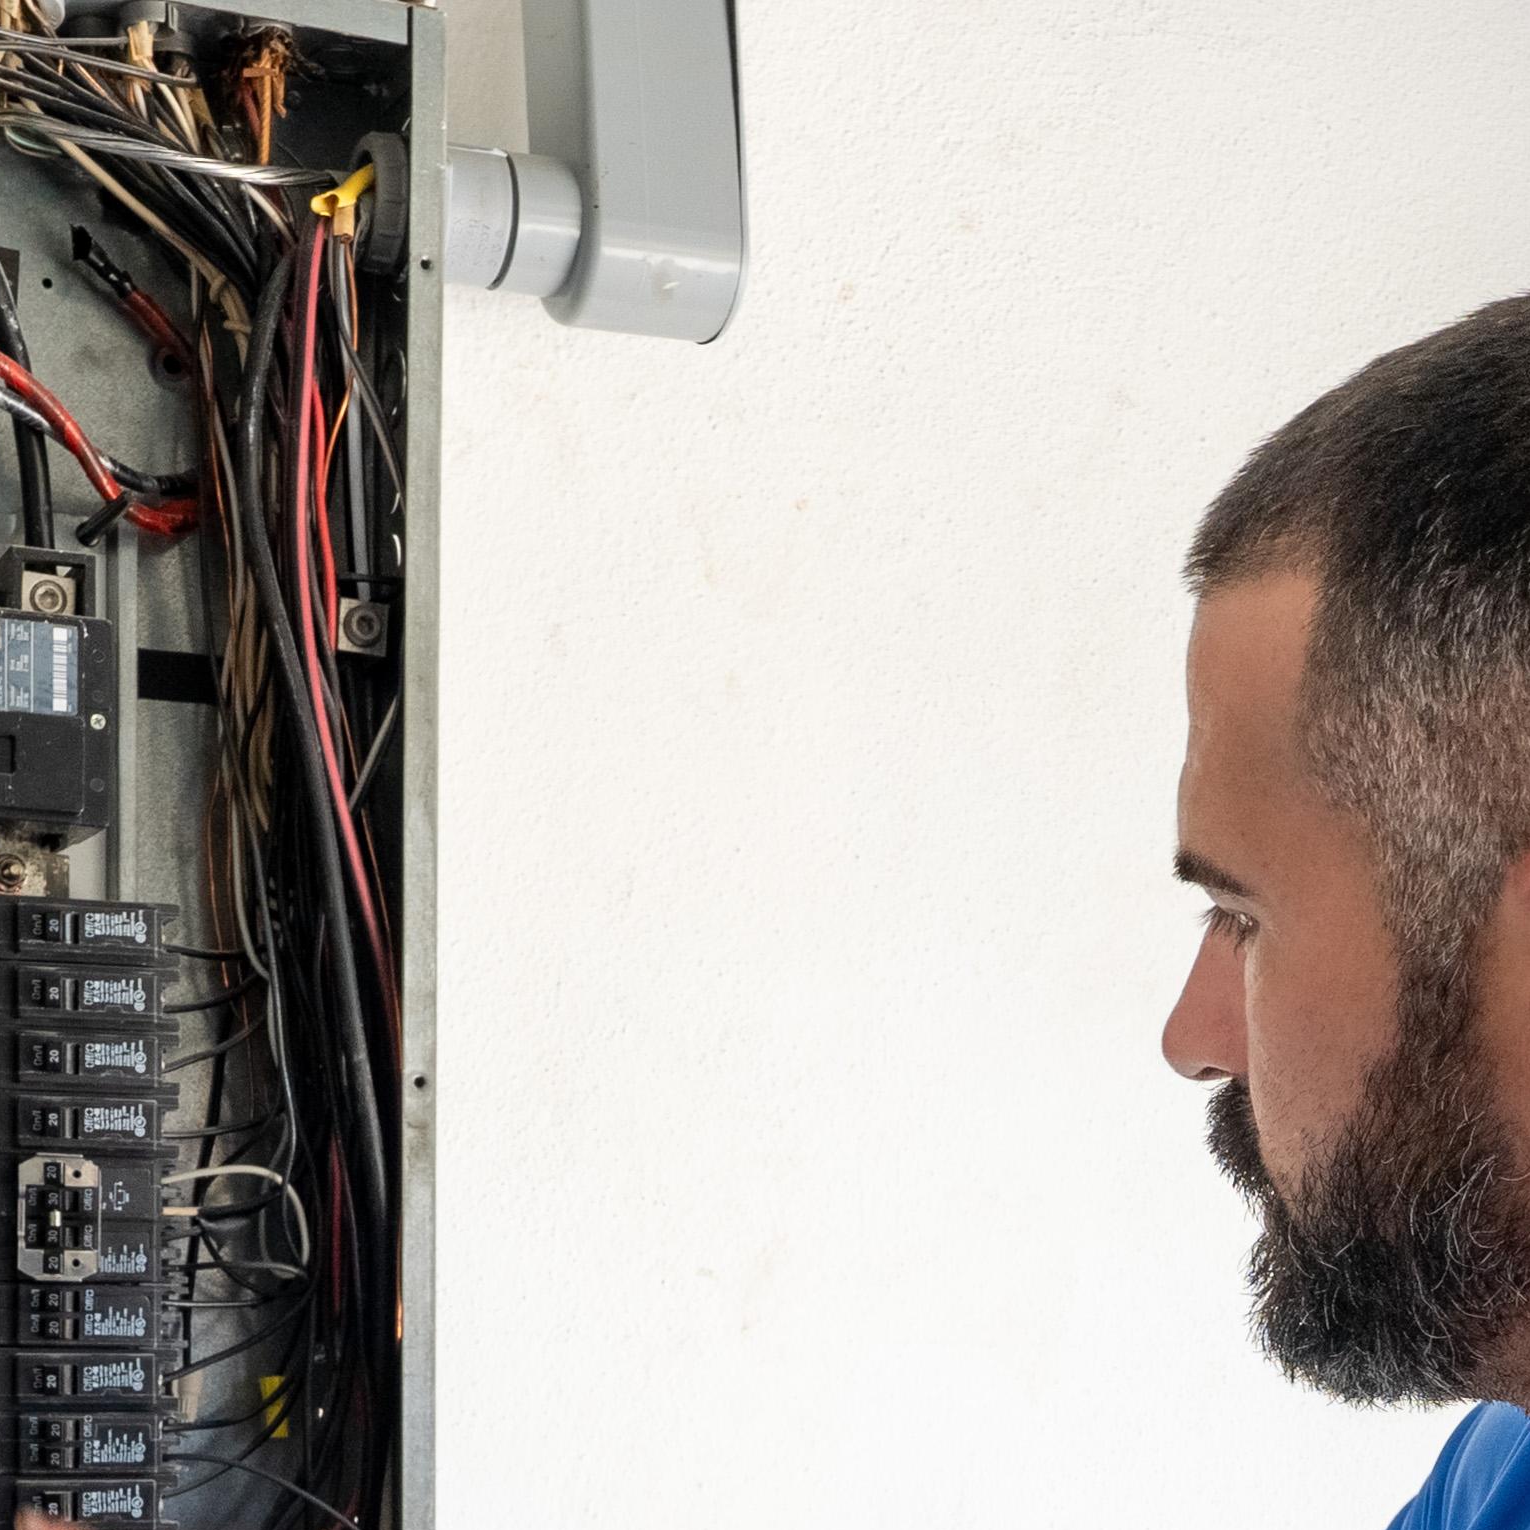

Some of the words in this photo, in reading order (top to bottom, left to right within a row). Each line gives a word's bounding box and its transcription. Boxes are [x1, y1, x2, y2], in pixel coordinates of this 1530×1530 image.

[49, 919, 58, 932] 20
[49, 987, 59, 999] 20
[49, 1050, 59, 1063] 20
[49, 1113, 58, 1126] 20
[47, 1166, 57, 1179] 20
[49, 1193, 58, 1205] 30
[48, 1230, 57, 1242] 30
[48, 1257, 58, 1269] 20
[49, 1294, 58, 1306] 20
[49, 1321, 59, 1334] 20
[47, 1375, 57, 1388] 20
[51, 1424, 60, 1436] 20
[51, 1453, 60, 1465] 20
[48, 1503, 58, 1515] 20
